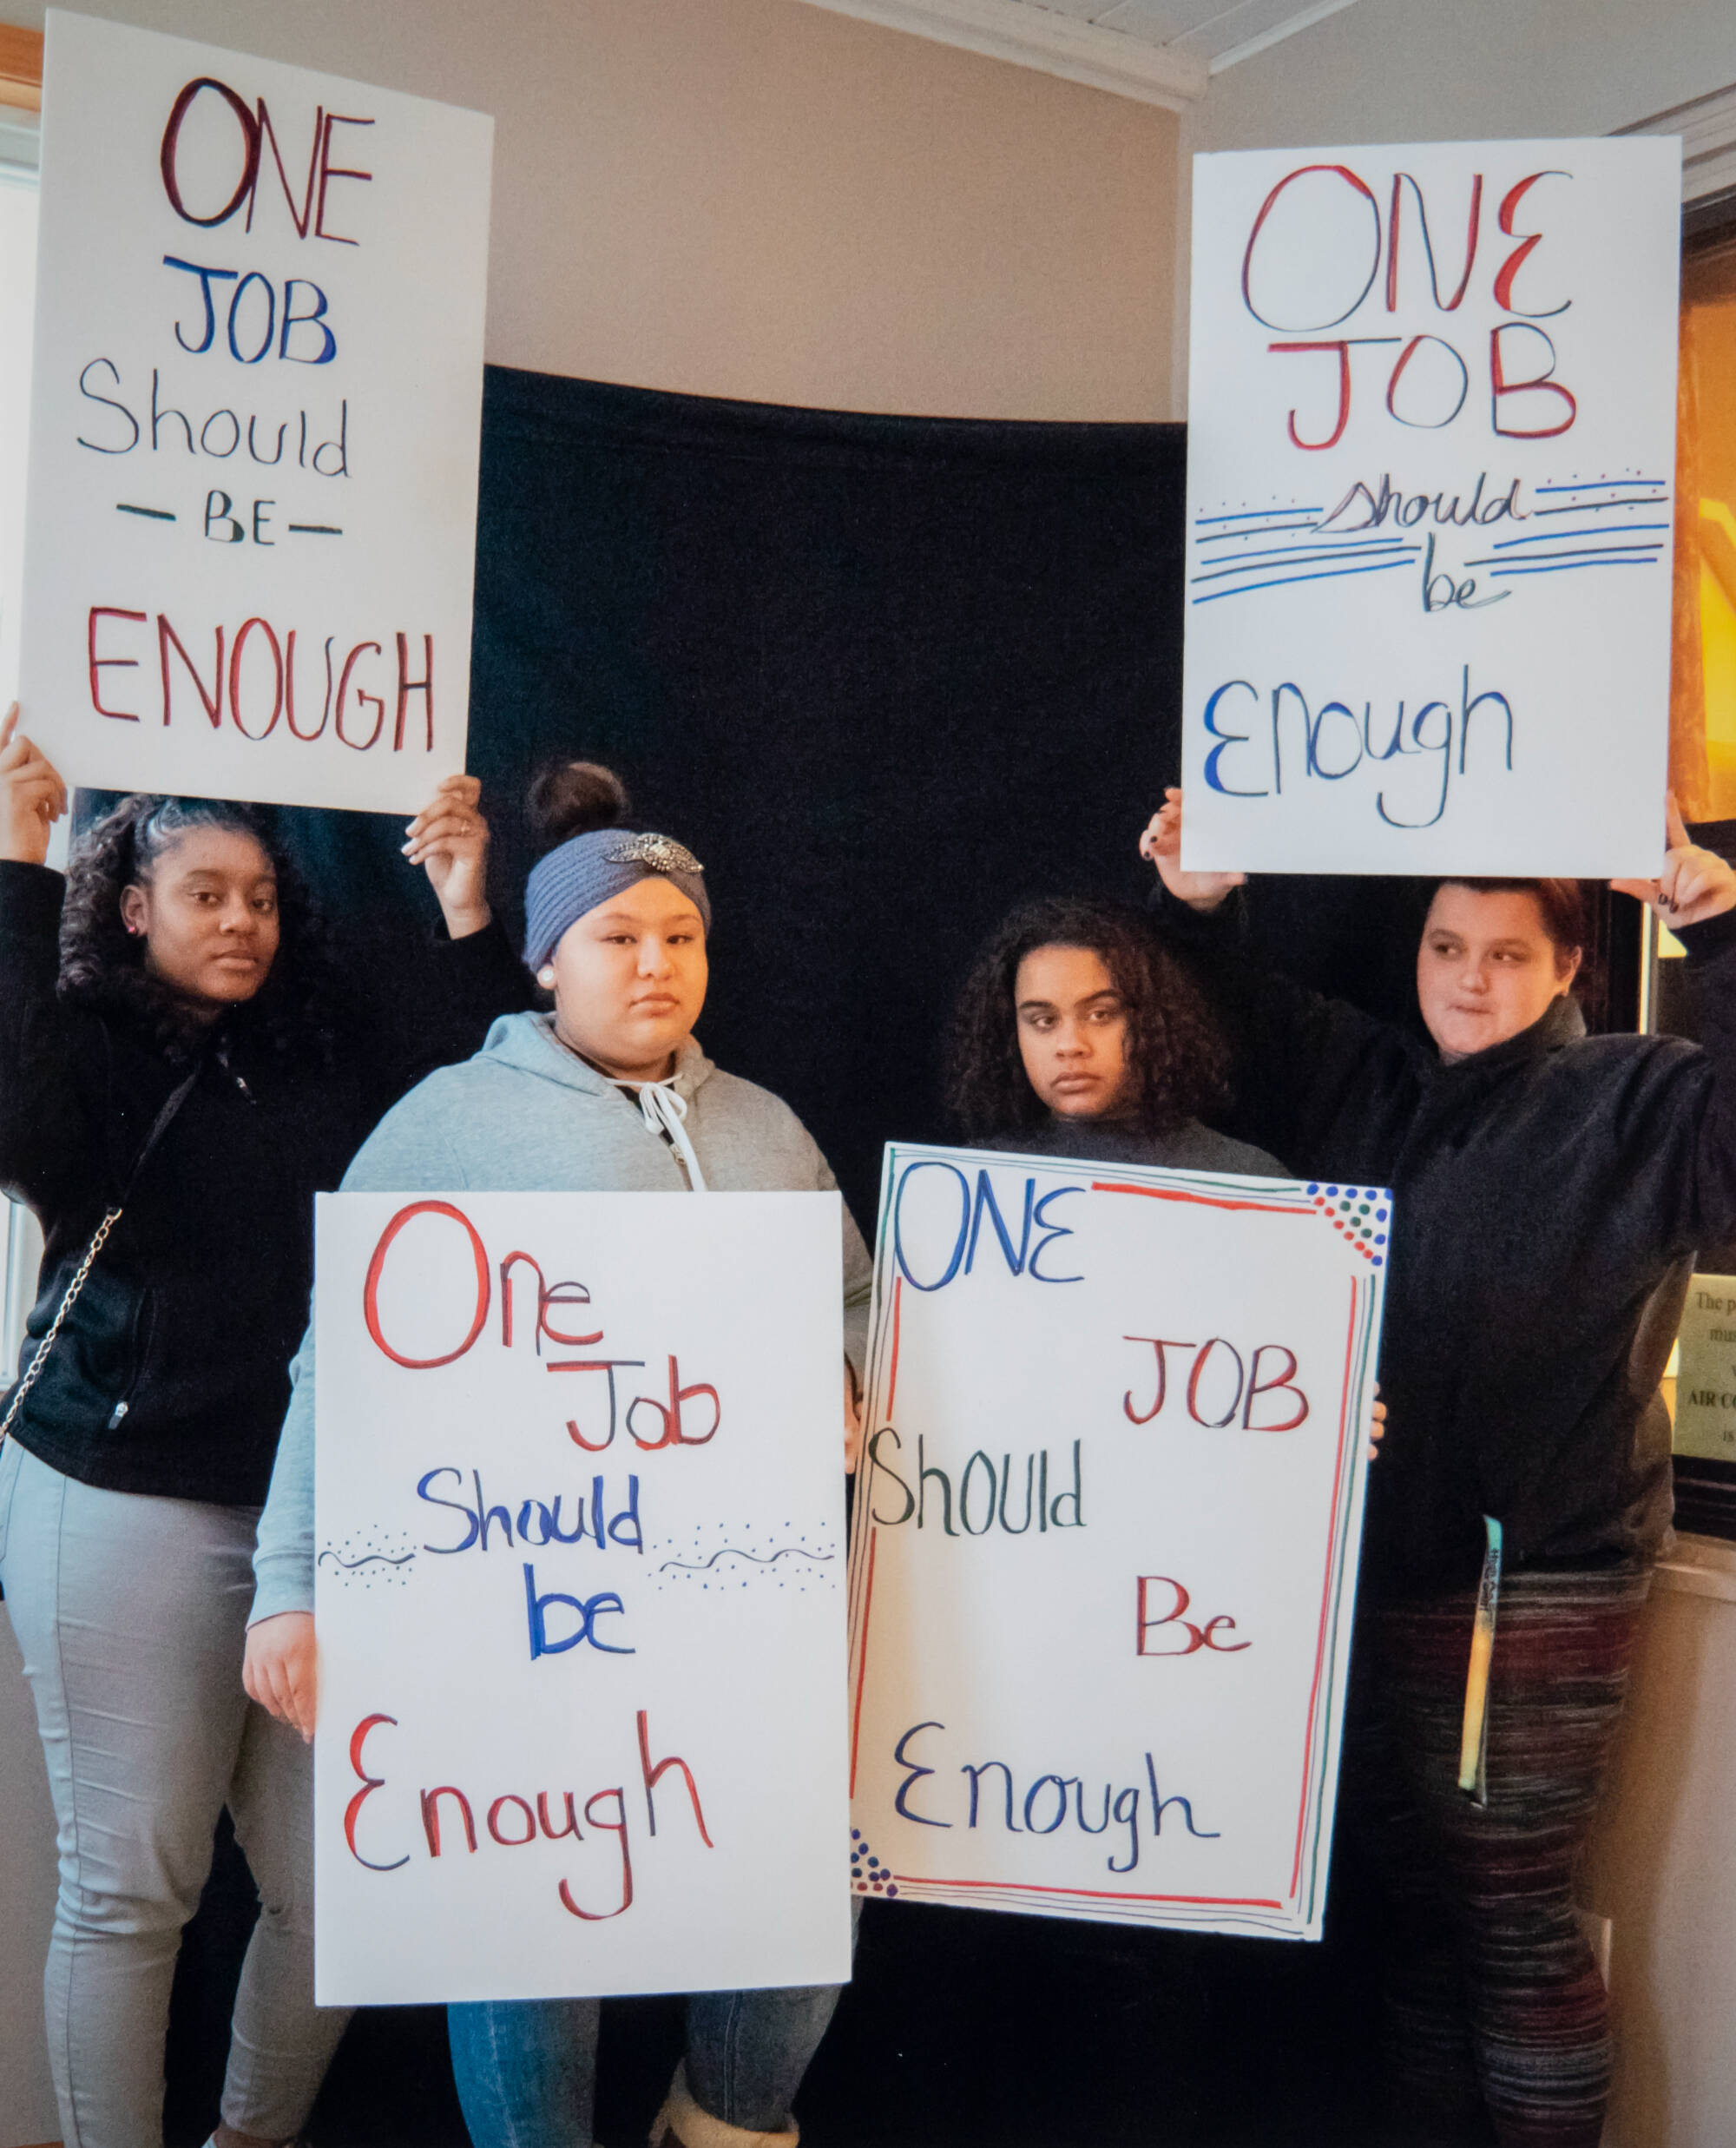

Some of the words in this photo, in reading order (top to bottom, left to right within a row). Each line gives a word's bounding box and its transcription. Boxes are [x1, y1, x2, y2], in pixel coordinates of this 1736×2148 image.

[161, 76, 376, 247] ONE
[1241, 164, 1574, 333] ONE
[162, 255, 337, 365] JOB
[76, 357, 353, 479] Should
[1267, 322, 1577, 451] JOB
[1312, 472, 1534, 533] should
[1422, 533, 1512, 612] be
[88, 605, 433, 753] ENOUGH
[1203, 664, 1514, 828] Enough
[363, 1200, 605, 1369] One
[893, 1161, 1087, 1292] ONE
[1694, 1291, 1724, 1311] The
[546, 1355, 720, 1452] Job
[1121, 1335, 1310, 1433] JOB
[1687, 1389, 1717, 1407] AIR
[416, 1467, 644, 1555] Should
[523, 1563, 637, 1661] be
[1136, 1575, 1252, 1657] Be
[344, 1710, 714, 1921] Enough
[893, 1721, 1221, 1873] Enough
